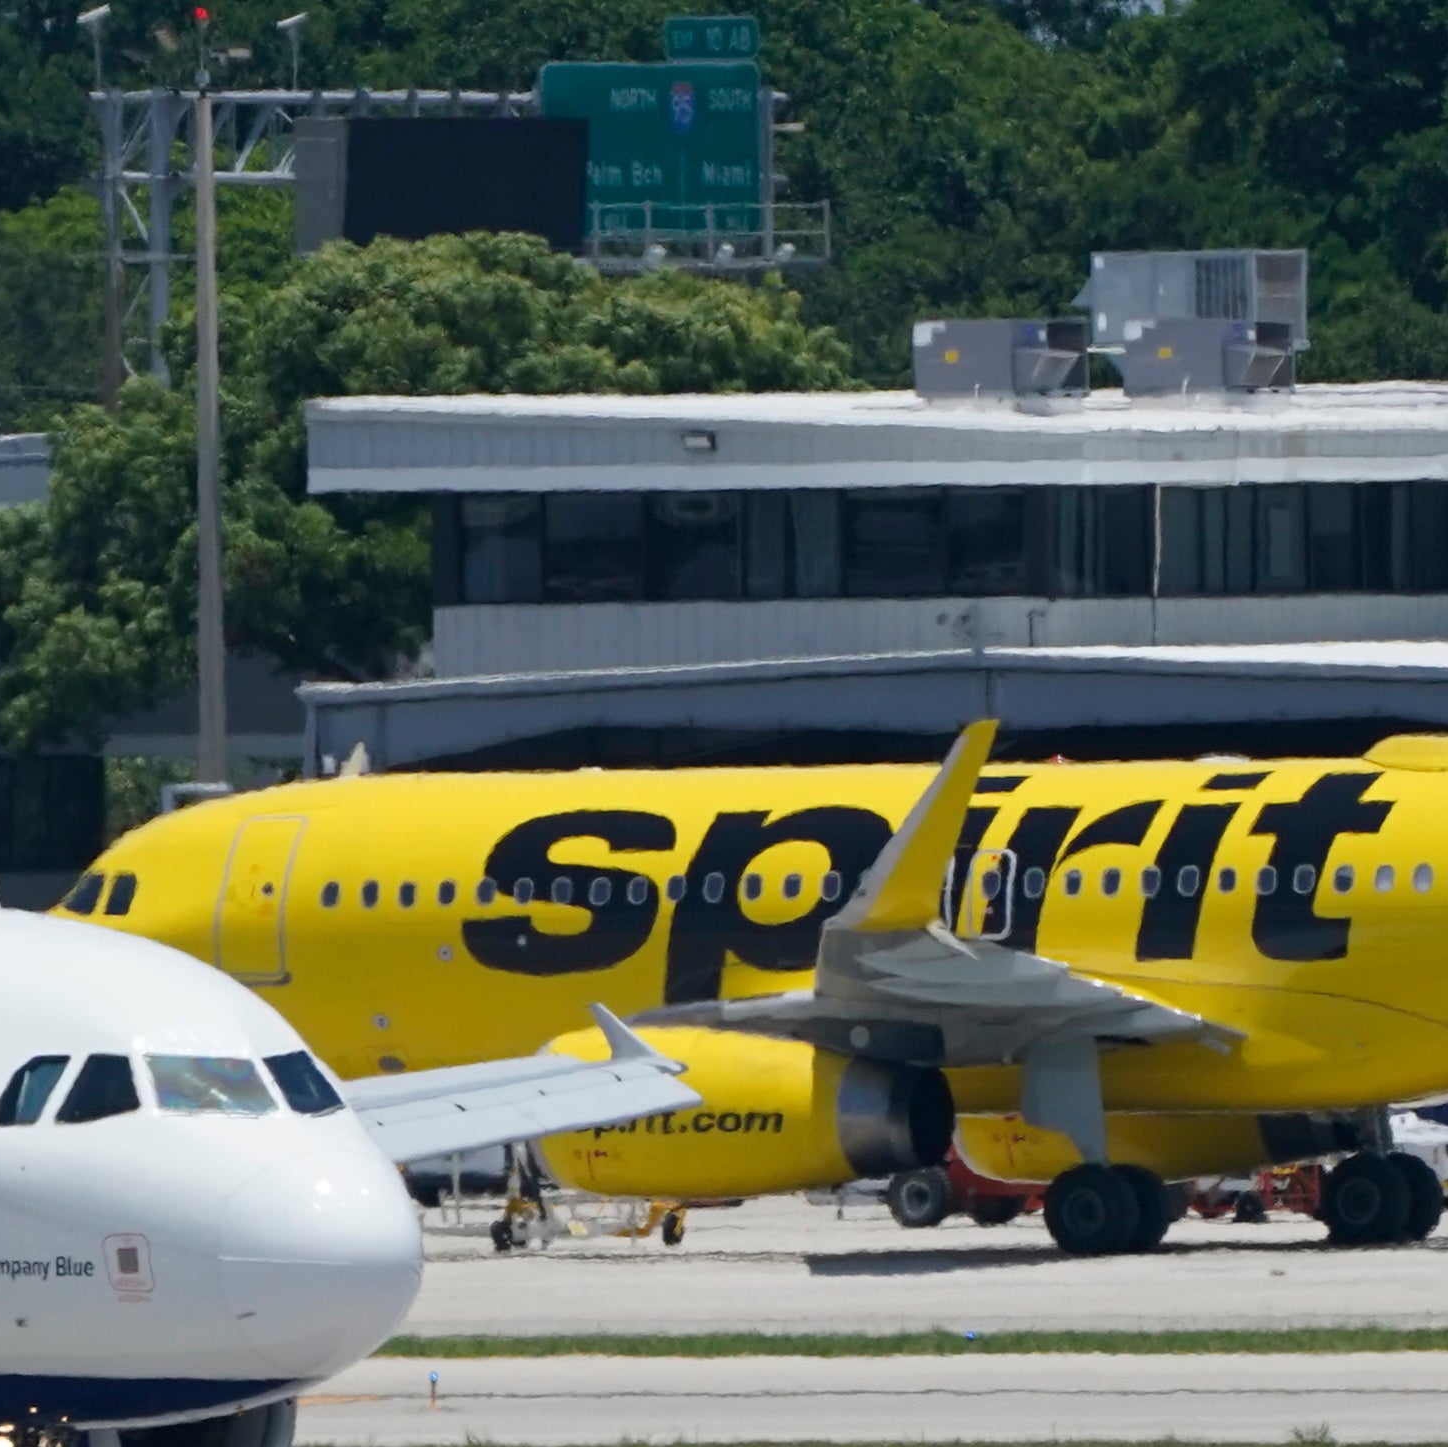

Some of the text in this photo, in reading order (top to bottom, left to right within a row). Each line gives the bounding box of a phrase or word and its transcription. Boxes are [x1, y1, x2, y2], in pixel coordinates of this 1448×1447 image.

[611, 87, 752, 124] NORTH 95 SOUTH
[703, 160, 750, 187] Miami
[461, 772, 1394, 1002] spirit
[56, 1255, 95, 1277] Blue
